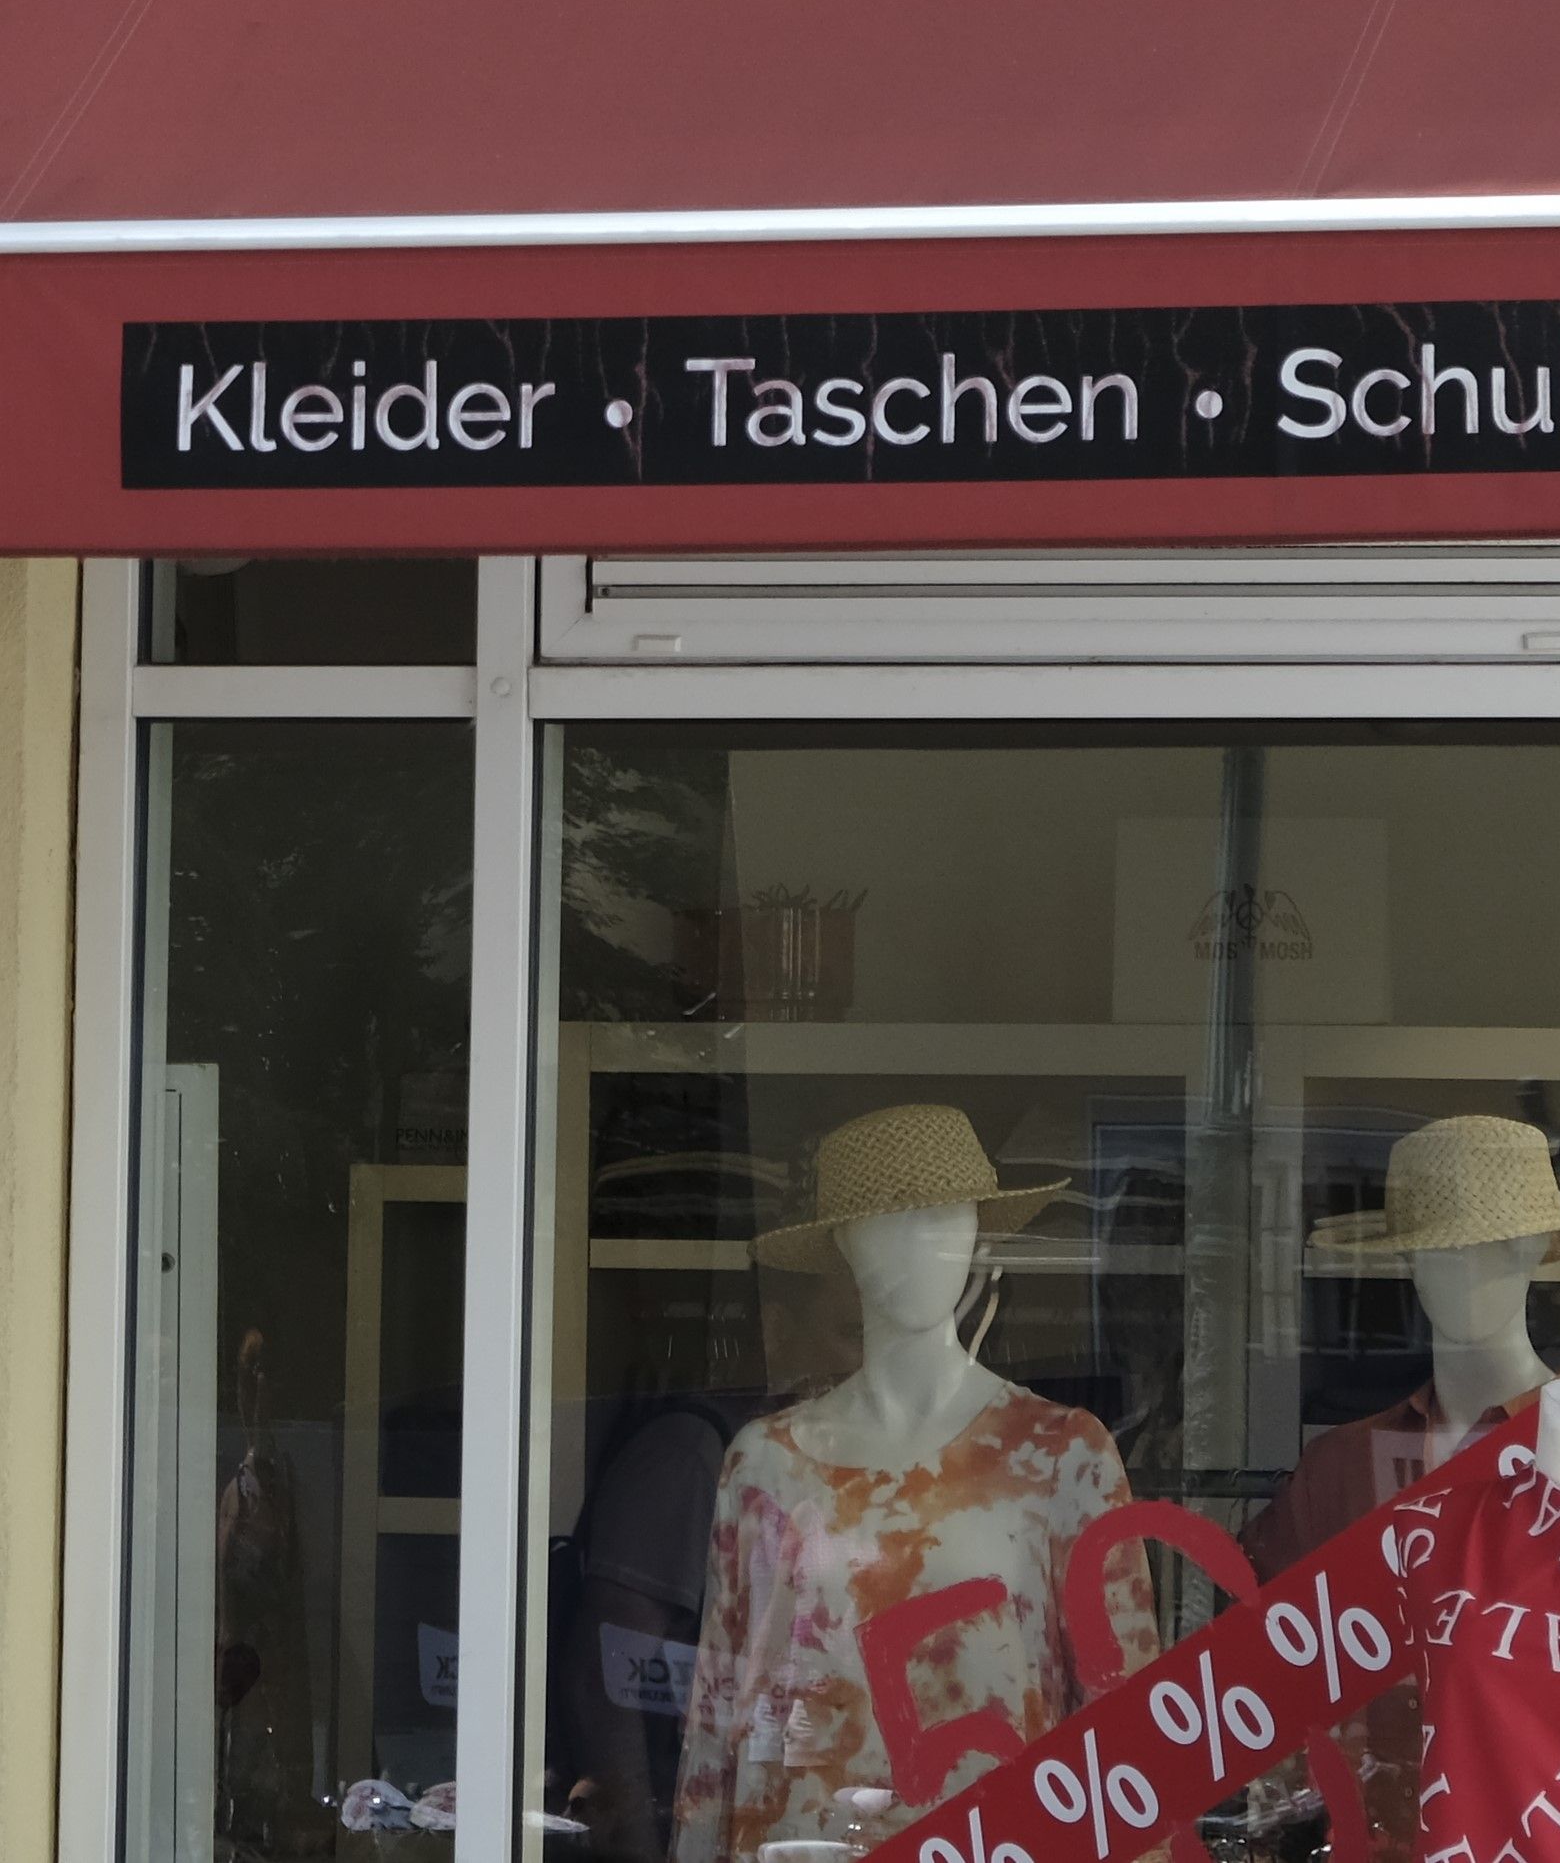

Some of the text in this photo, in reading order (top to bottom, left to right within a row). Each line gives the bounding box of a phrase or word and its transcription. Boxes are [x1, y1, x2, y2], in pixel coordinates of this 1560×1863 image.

[177, 359, 557, 455] Kleider
[684, 351, 1140, 449] Taschen
[1259, 941, 1313, 961] MOSH
